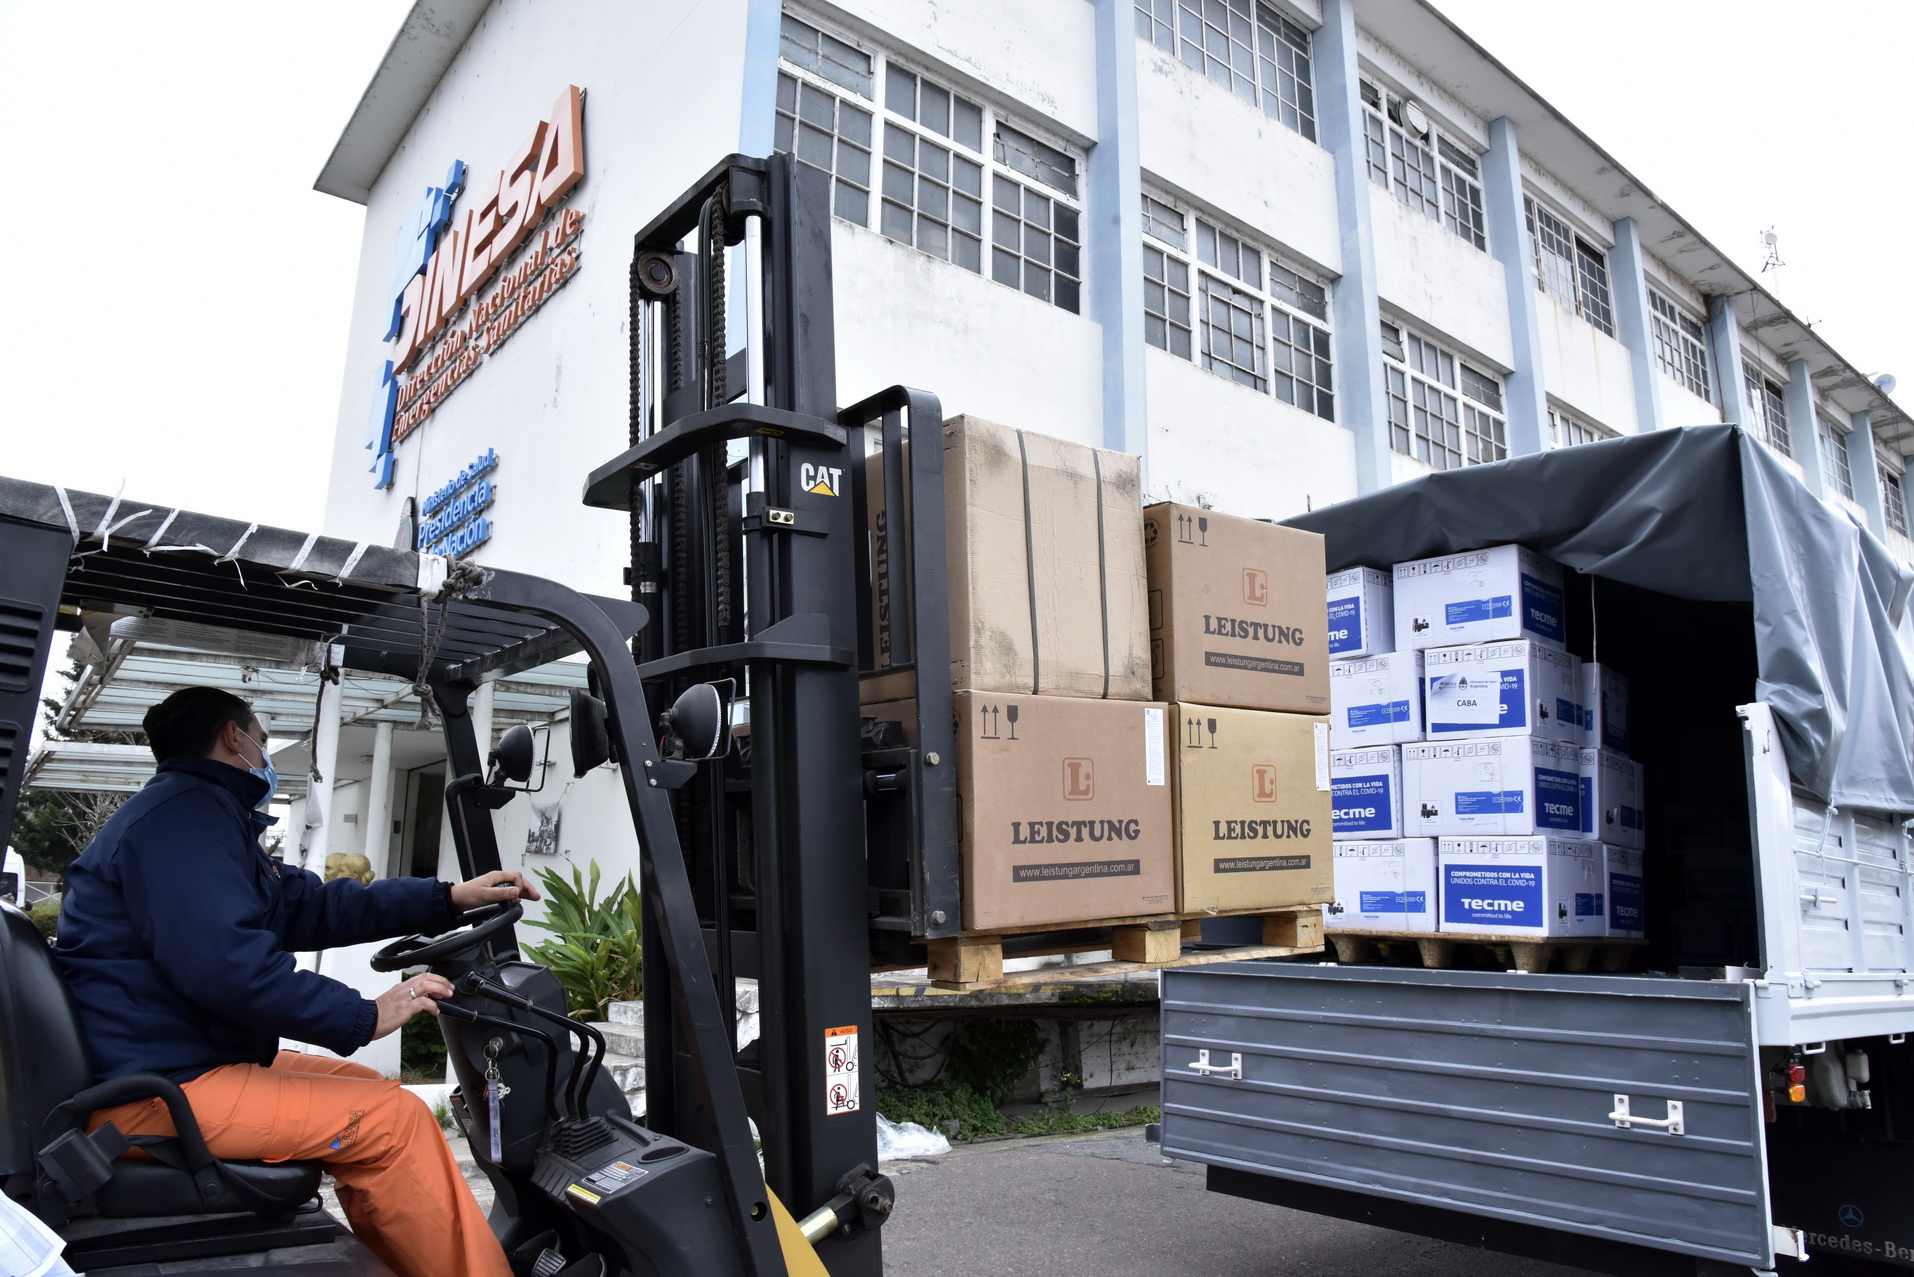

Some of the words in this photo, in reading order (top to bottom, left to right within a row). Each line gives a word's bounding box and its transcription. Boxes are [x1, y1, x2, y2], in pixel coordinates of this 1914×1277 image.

[392, 84, 585, 376] DINESA
[396, 329, 465, 412] Dirección
[468, 230, 549, 339] Nacional
[554, 208, 581, 249] de
[390, 344, 481, 443] Emergencias
[477, 247, 577, 354] Sanitarias
[422, 479, 456, 516] Ministerio
[467, 447, 494, 479] Salud
[800, 462, 842, 497] CAT
[417, 478, 491, 548] Presidencia
[441, 515, 488, 557] Nación
[1203, 614, 1304, 647] LEISTUNG
[1209, 655, 1300, 673] www.leistungargentina.com.ar
[1456, 699, 1477, 707] CABA
[1332, 789, 1352, 797] CONTRA
[1331, 807, 1376, 820] ecme
[1011, 819, 1141, 845] LEISTUNG
[1212, 819, 1311, 841] LEISTUNG
[1019, 862, 1135, 878] www.leistungargentina.com.ar
[1219, 857, 1307, 870] www.leistungargentina.com.ar
[1507, 879, 1536, 887] COVID-19
